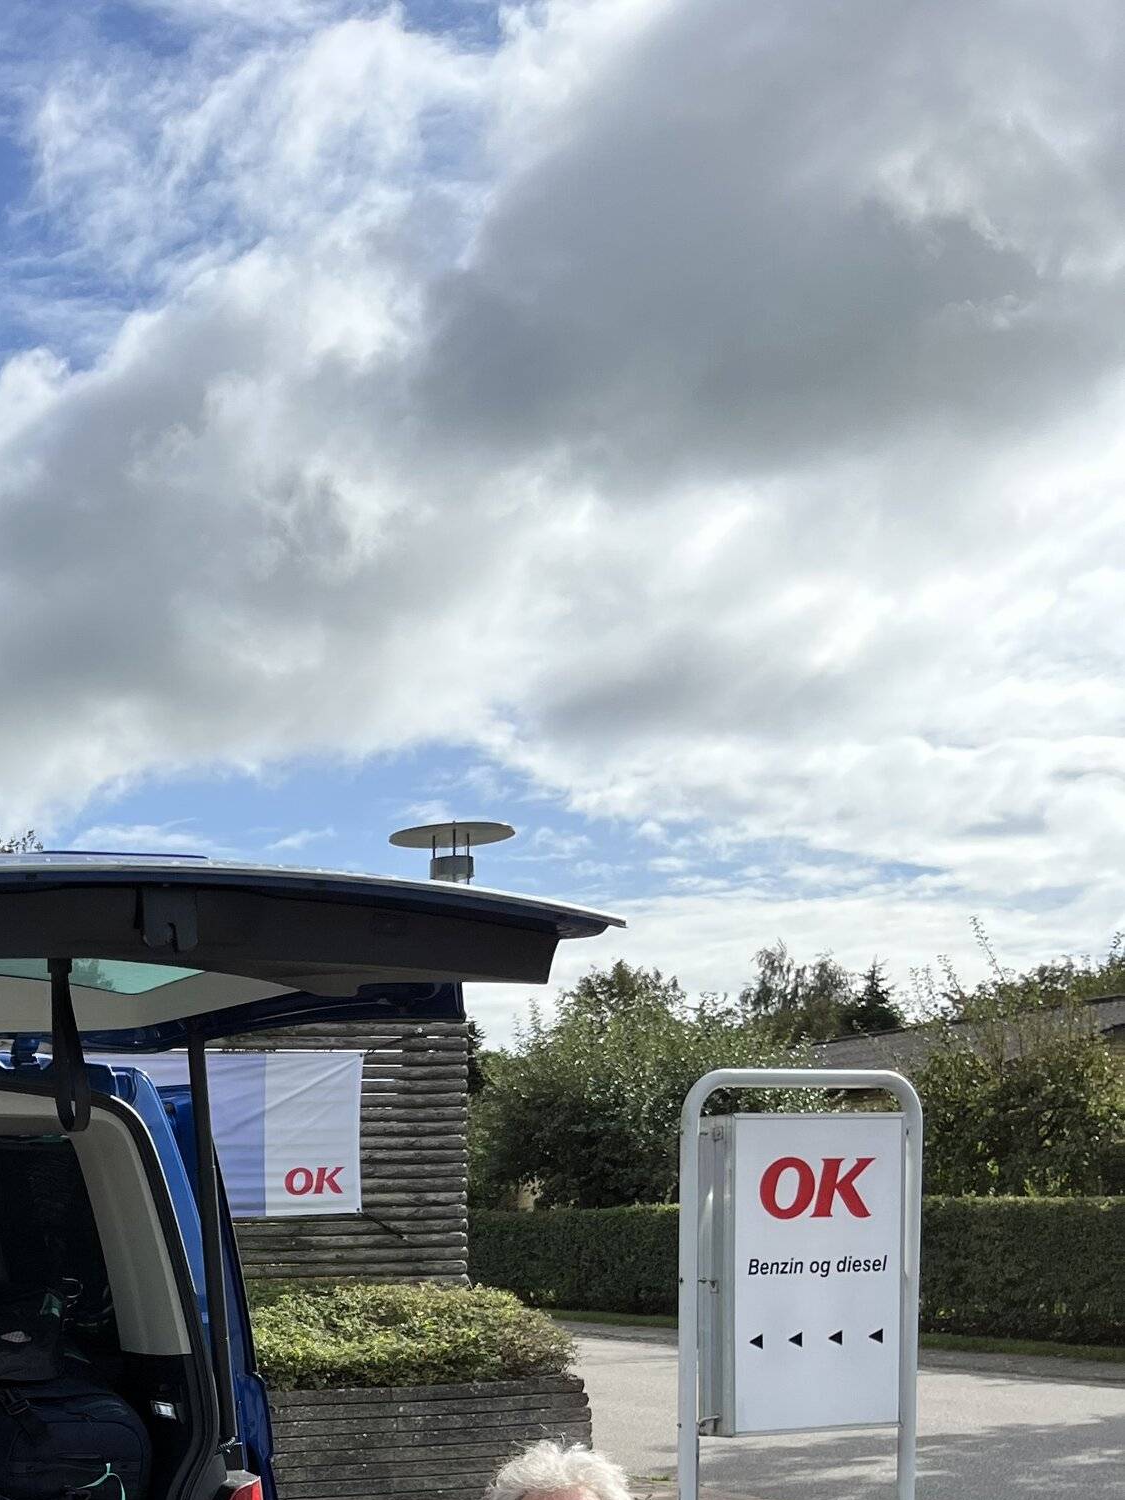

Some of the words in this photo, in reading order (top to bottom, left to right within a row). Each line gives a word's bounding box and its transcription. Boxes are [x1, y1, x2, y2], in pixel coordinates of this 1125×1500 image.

[284, 1166, 345, 1196] OK
[760, 1157, 876, 1220] OK
[748, 1257, 804, 1275] Benzin
[809, 1260, 831, 1278] og
[836, 1255, 888, 1273] diesel
